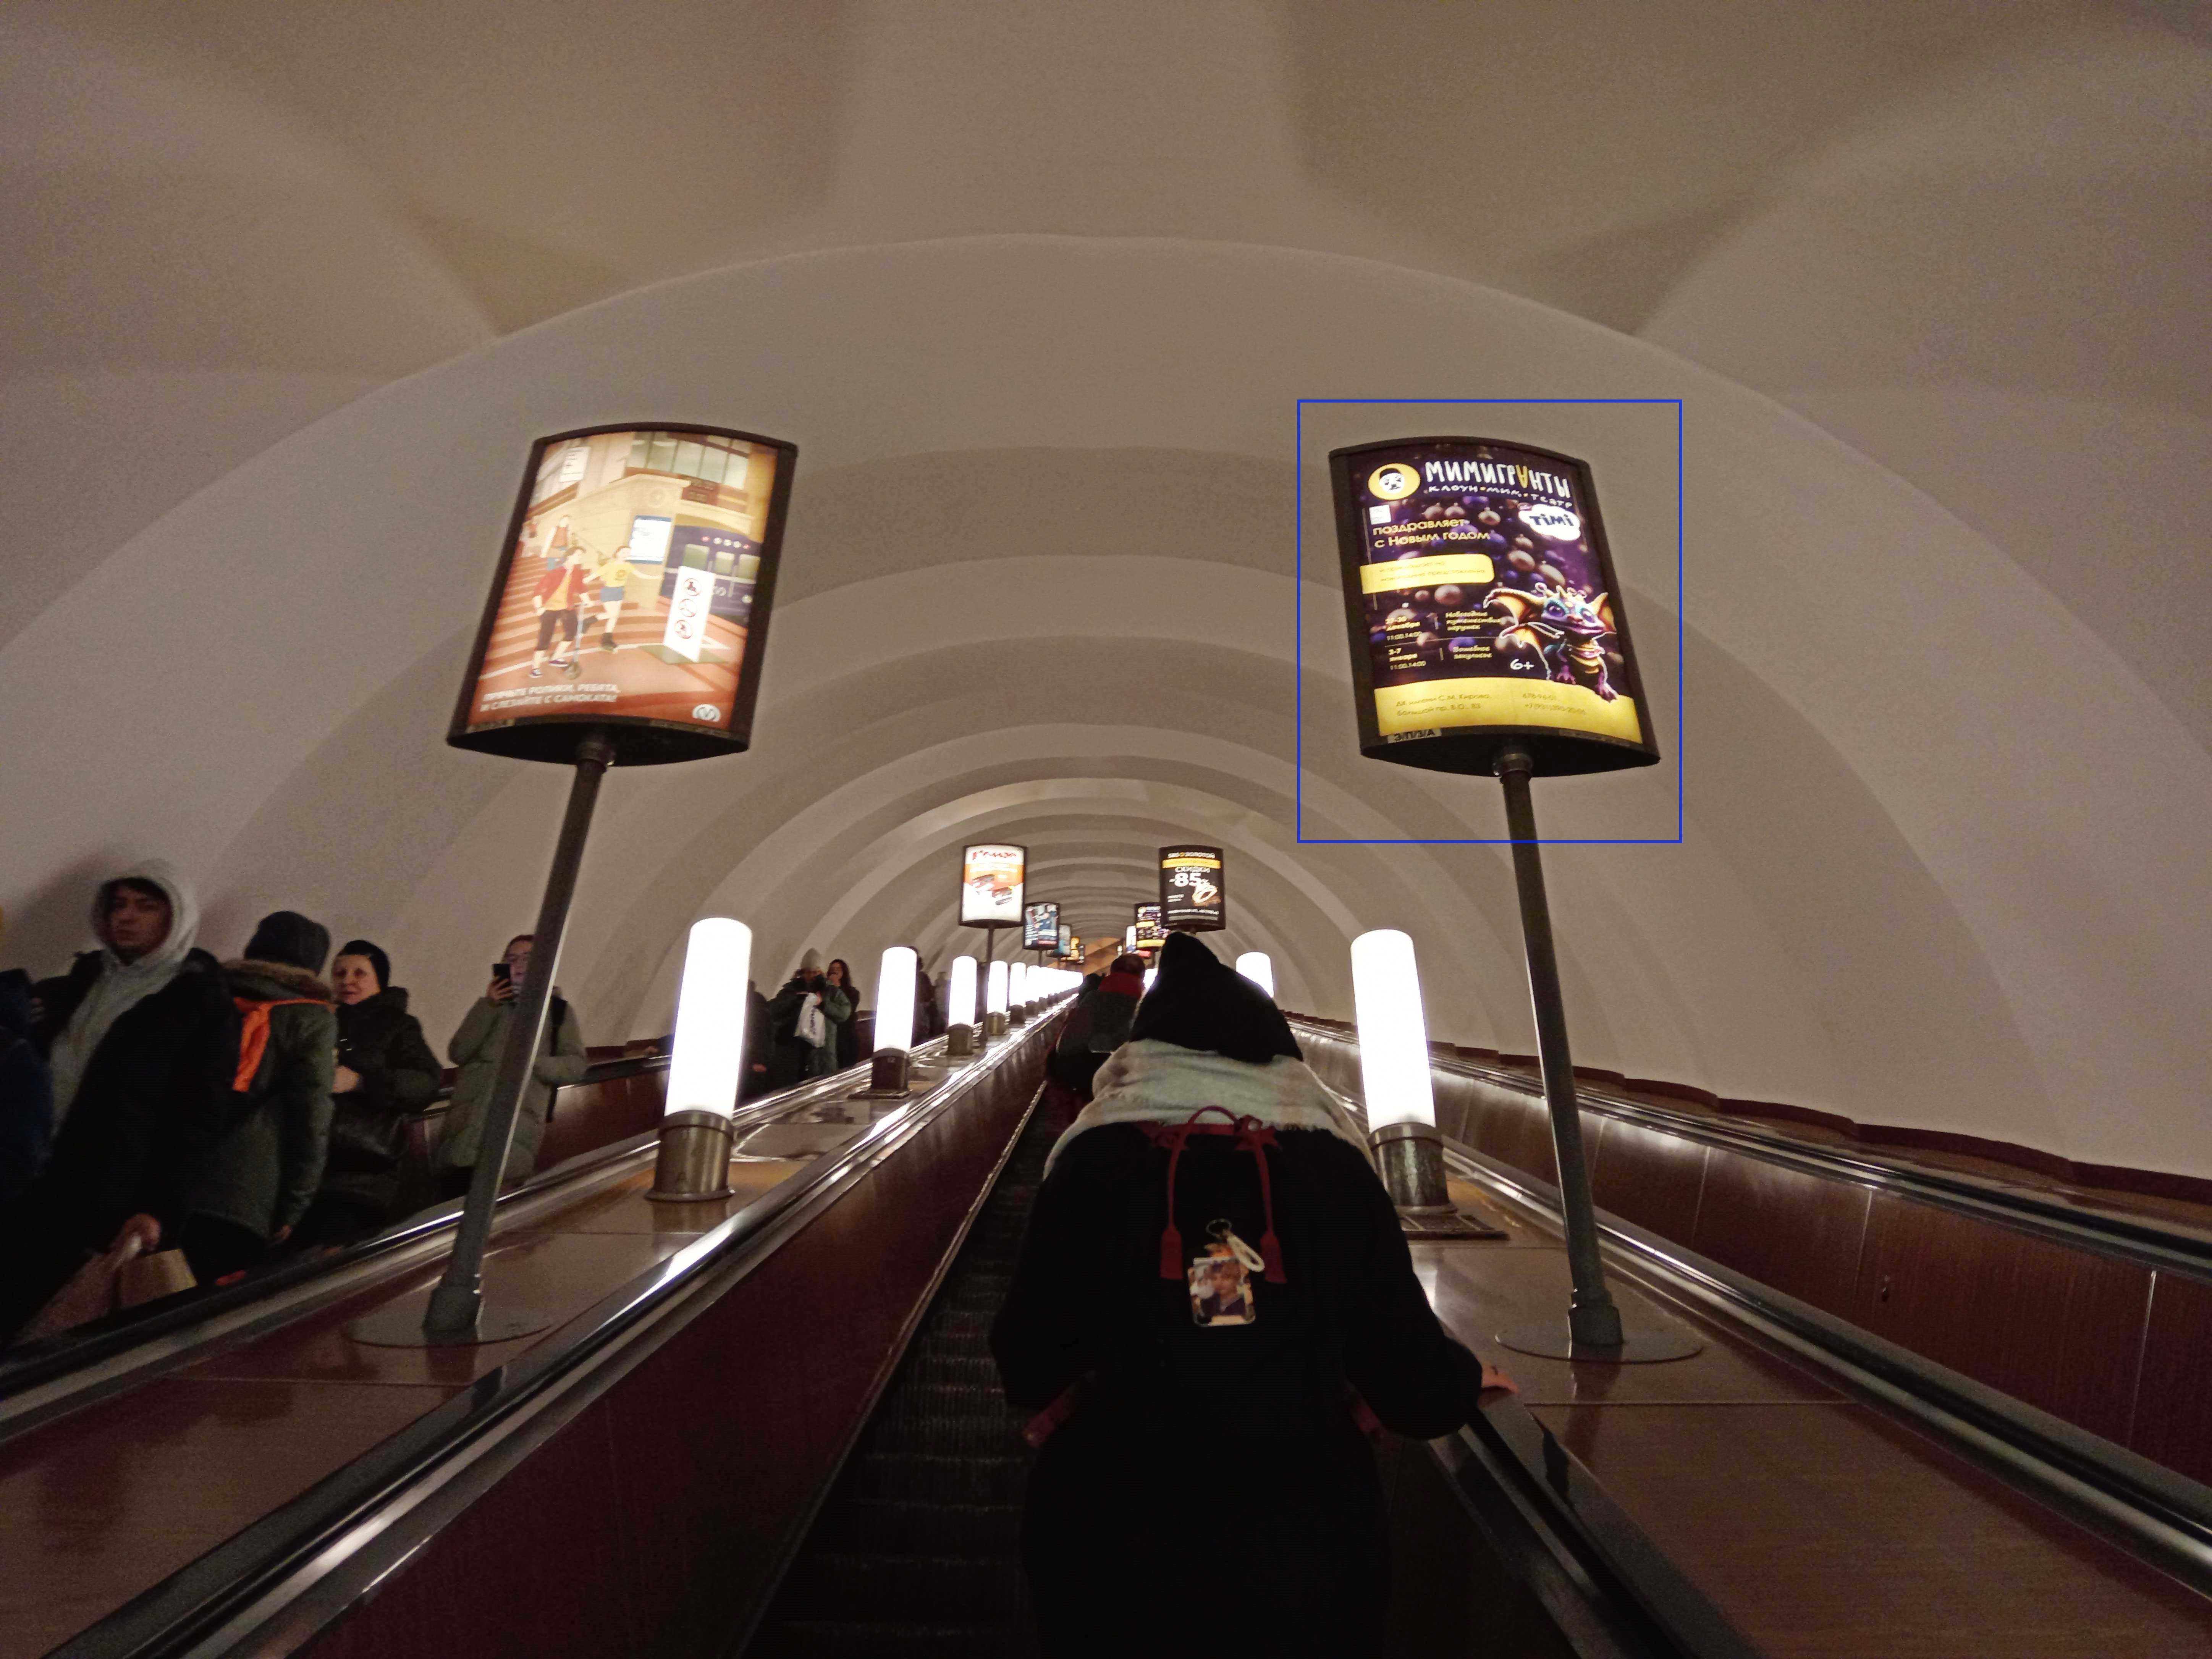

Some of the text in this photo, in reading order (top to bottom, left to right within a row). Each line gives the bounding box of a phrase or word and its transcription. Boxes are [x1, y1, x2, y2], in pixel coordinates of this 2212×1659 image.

[1388, 533, 1440, 546] Новым
[1442, 532, 1491, 540] годом
[1510, 658, 1534, 670] 6+
